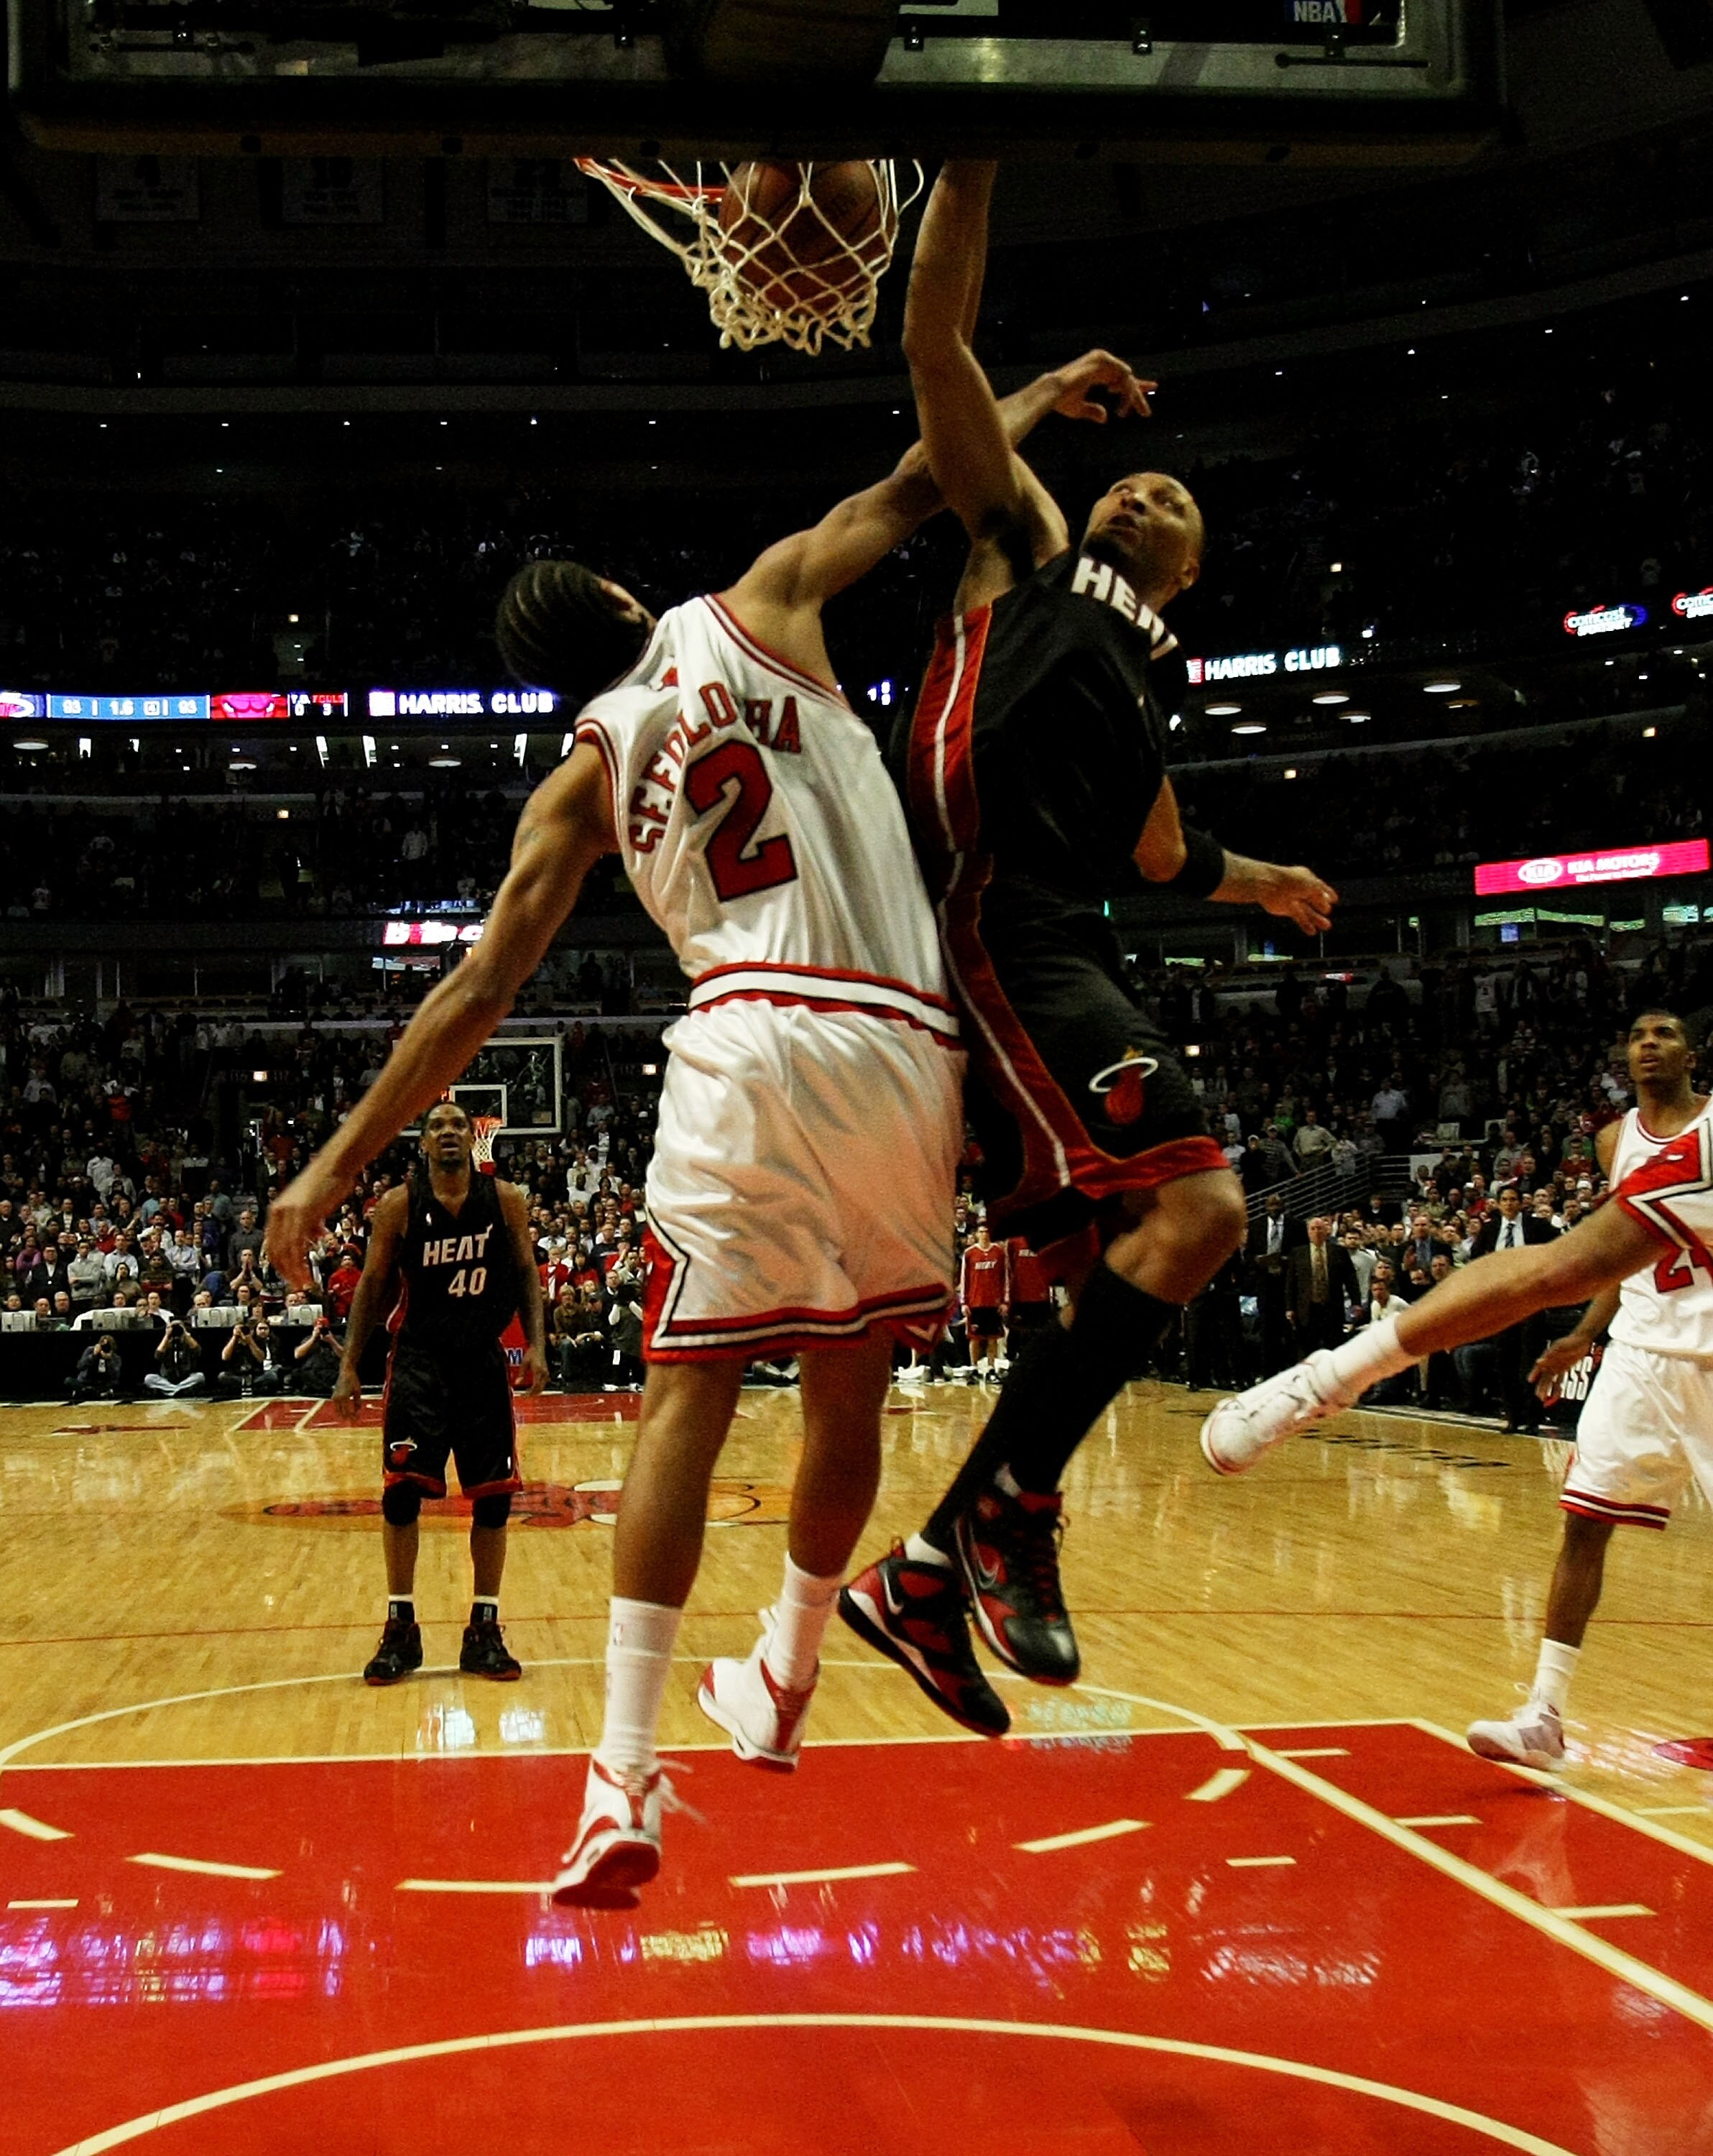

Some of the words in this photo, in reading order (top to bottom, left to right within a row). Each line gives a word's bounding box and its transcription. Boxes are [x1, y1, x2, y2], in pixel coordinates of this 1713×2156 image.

[1294, 1, 1337, 22] NBA
[1204, 654, 1277, 681] HARRIS
[1284, 647, 1340, 672] CLUB
[491, 692, 553, 714] CLUB
[683, 740, 798, 902] 2
[423, 1223, 494, 1267] HEAT
[448, 1266, 487, 1297] 40
